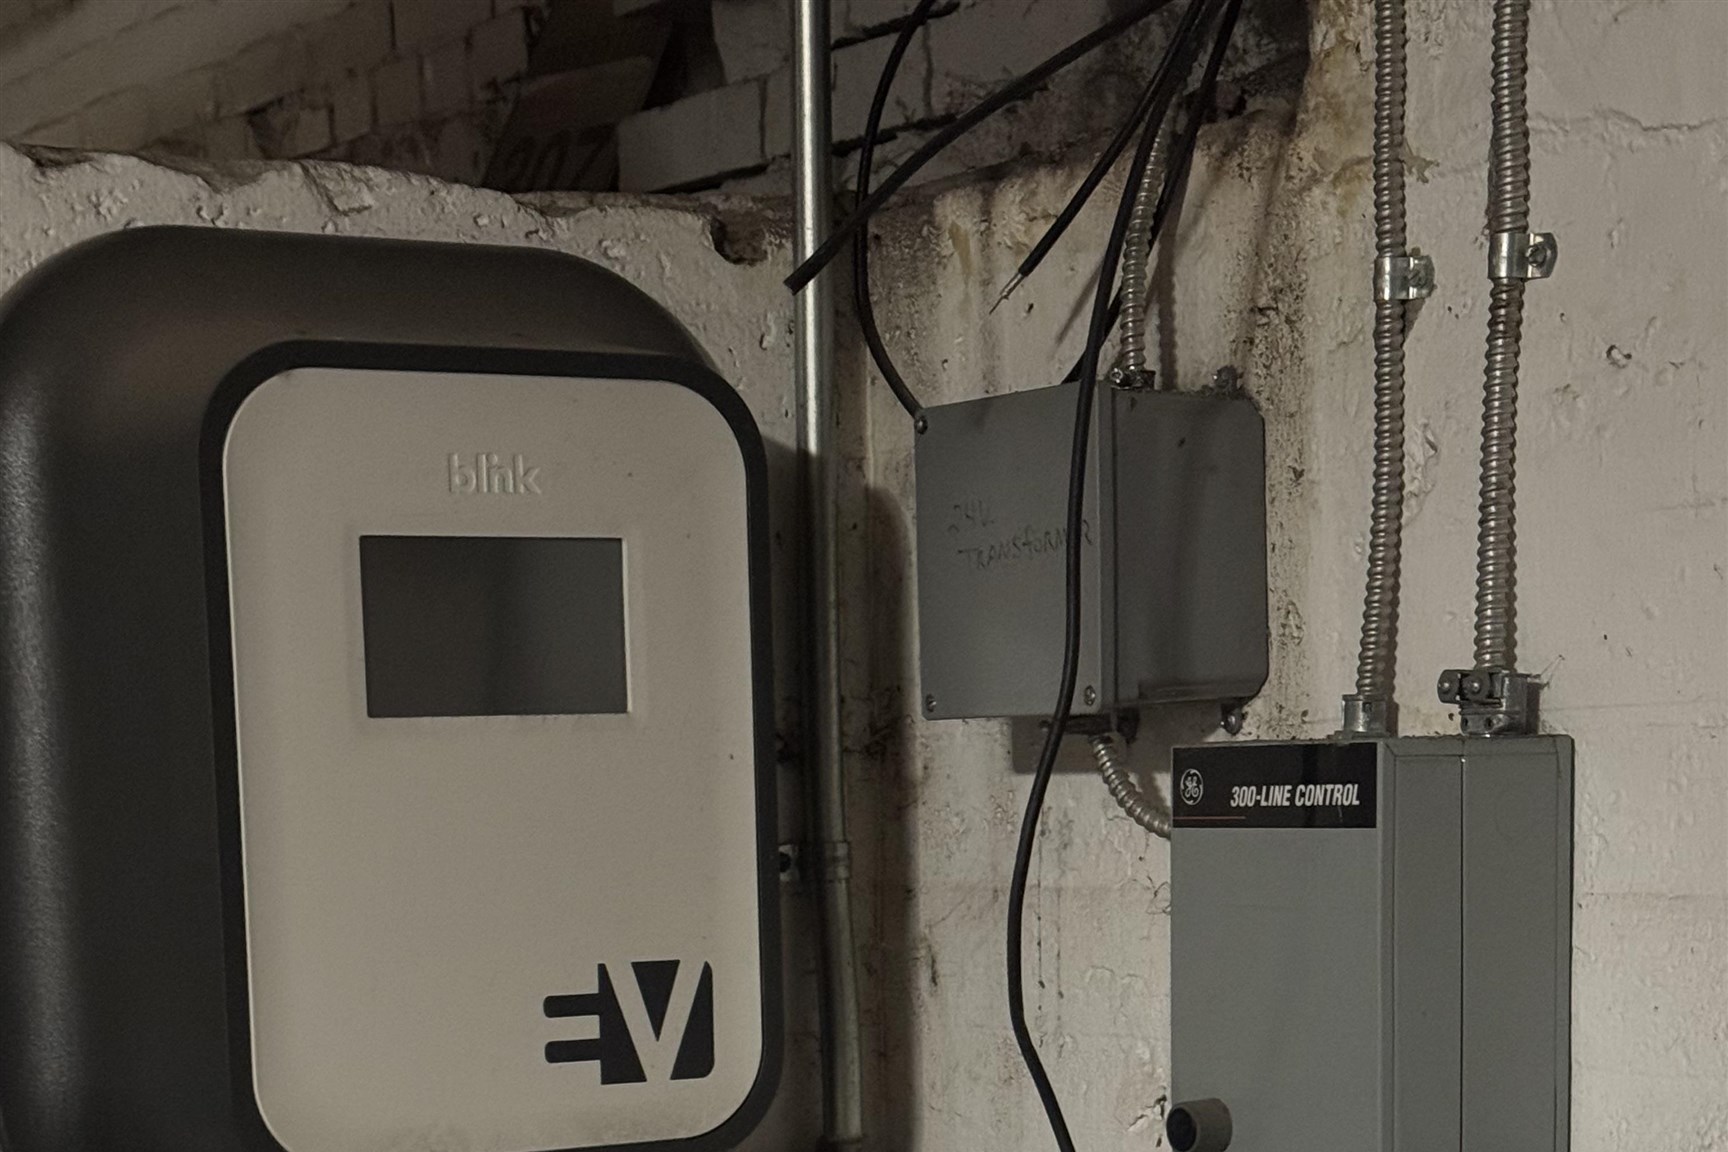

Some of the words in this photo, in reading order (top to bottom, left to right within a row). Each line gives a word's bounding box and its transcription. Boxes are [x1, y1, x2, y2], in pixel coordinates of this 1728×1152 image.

[448, 453, 541, 493] blink
[1230, 786, 1292, 807] 300-LINE
[1295, 784, 1360, 806] CONTROL
[543, 960, 715, 1085] EV
